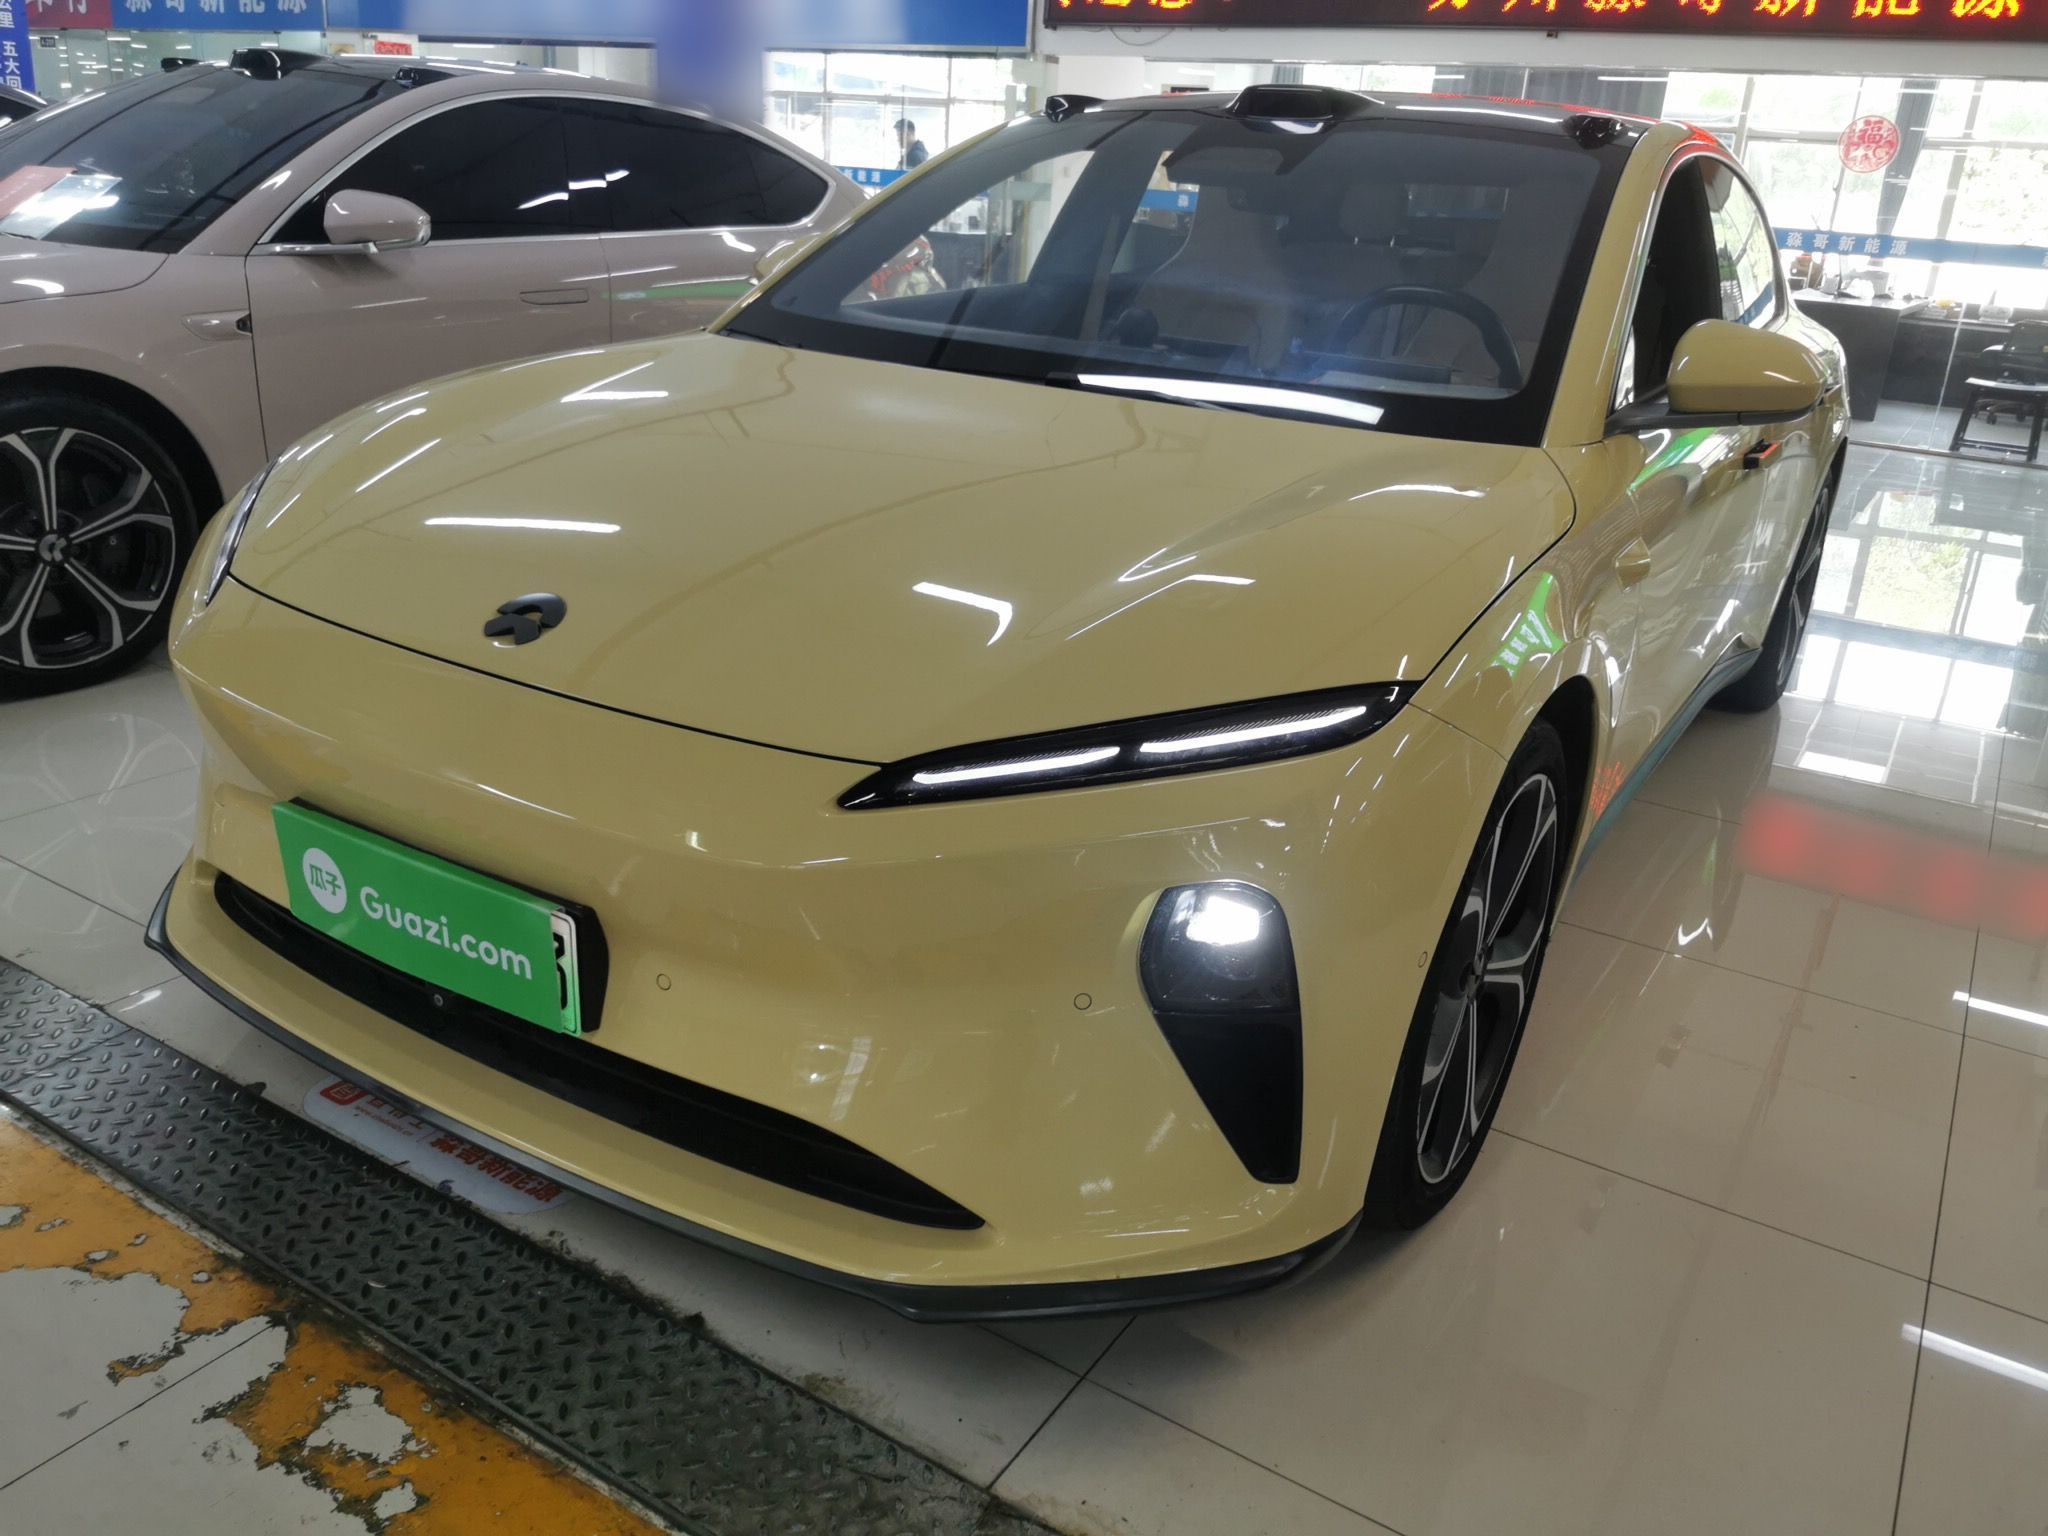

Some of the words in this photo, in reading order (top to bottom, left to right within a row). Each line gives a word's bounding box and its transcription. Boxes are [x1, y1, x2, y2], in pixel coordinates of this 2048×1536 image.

[1785, 231, 1908, 256] 淼哥新能源
[308, 862, 342, 898] 瓜子
[360, 886, 533, 980] Guazi.com
